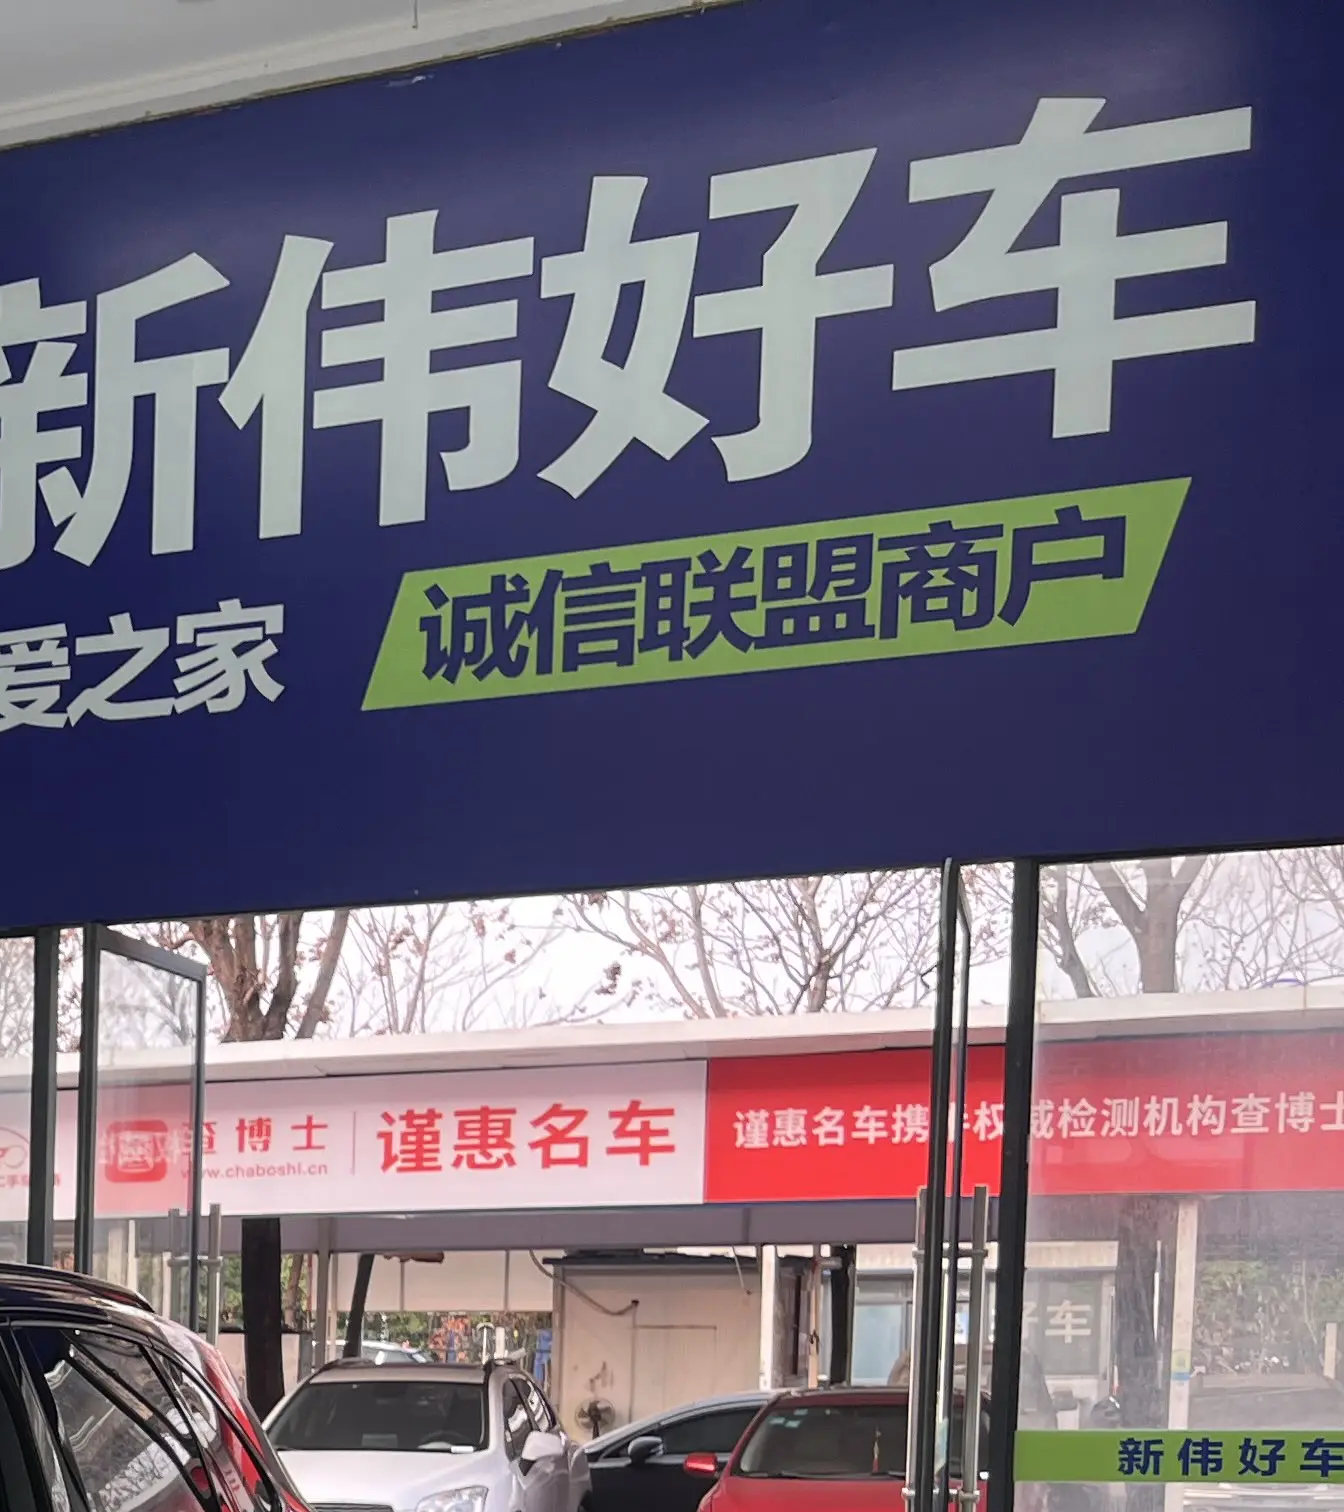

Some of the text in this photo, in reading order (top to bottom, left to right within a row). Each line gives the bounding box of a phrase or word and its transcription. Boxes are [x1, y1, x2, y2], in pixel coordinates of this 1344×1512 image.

[418, 505, 1129, 686] 诚信联盟商户
[376, 1100, 676, 1174] 谨惠名车
[1117, 1437, 1344, 1478] 新伟好车
